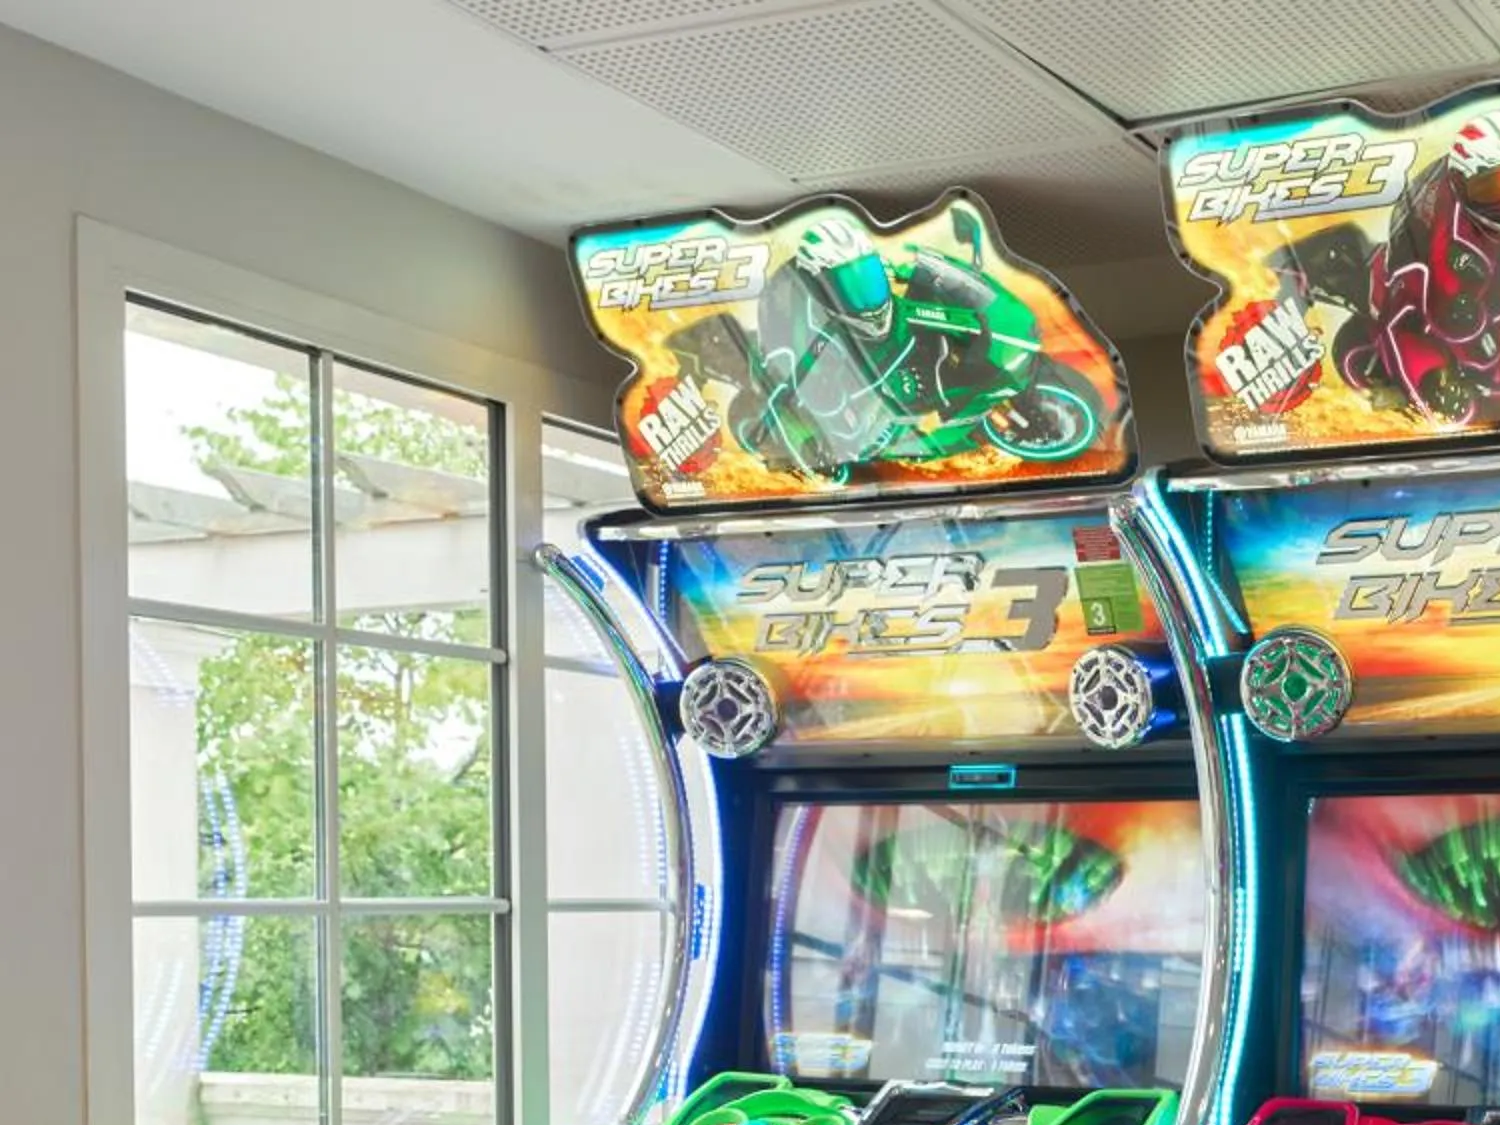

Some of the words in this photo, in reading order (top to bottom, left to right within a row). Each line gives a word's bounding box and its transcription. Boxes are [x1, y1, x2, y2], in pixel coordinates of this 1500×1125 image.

[1177, 132, 1365, 188] SUPER
[1345, 139, 1417, 213] 3
[1187, 170, 1349, 227] BIKES
[586, 236, 728, 279] SUPER
[716, 244, 769, 304] 3
[599, 271, 719, 311] BIKES
[1216, 297, 1309, 392] RAW
[1236, 335, 1325, 411] THRILLS
[638, 374, 707, 453] RAW
[659, 407, 722, 472] THRILLS
[736, 551, 985, 603] SUPER
[754, 604, 968, 657] BIKES
[987, 566, 1069, 651] 3
[1090, 603, 1106, 626] 3
